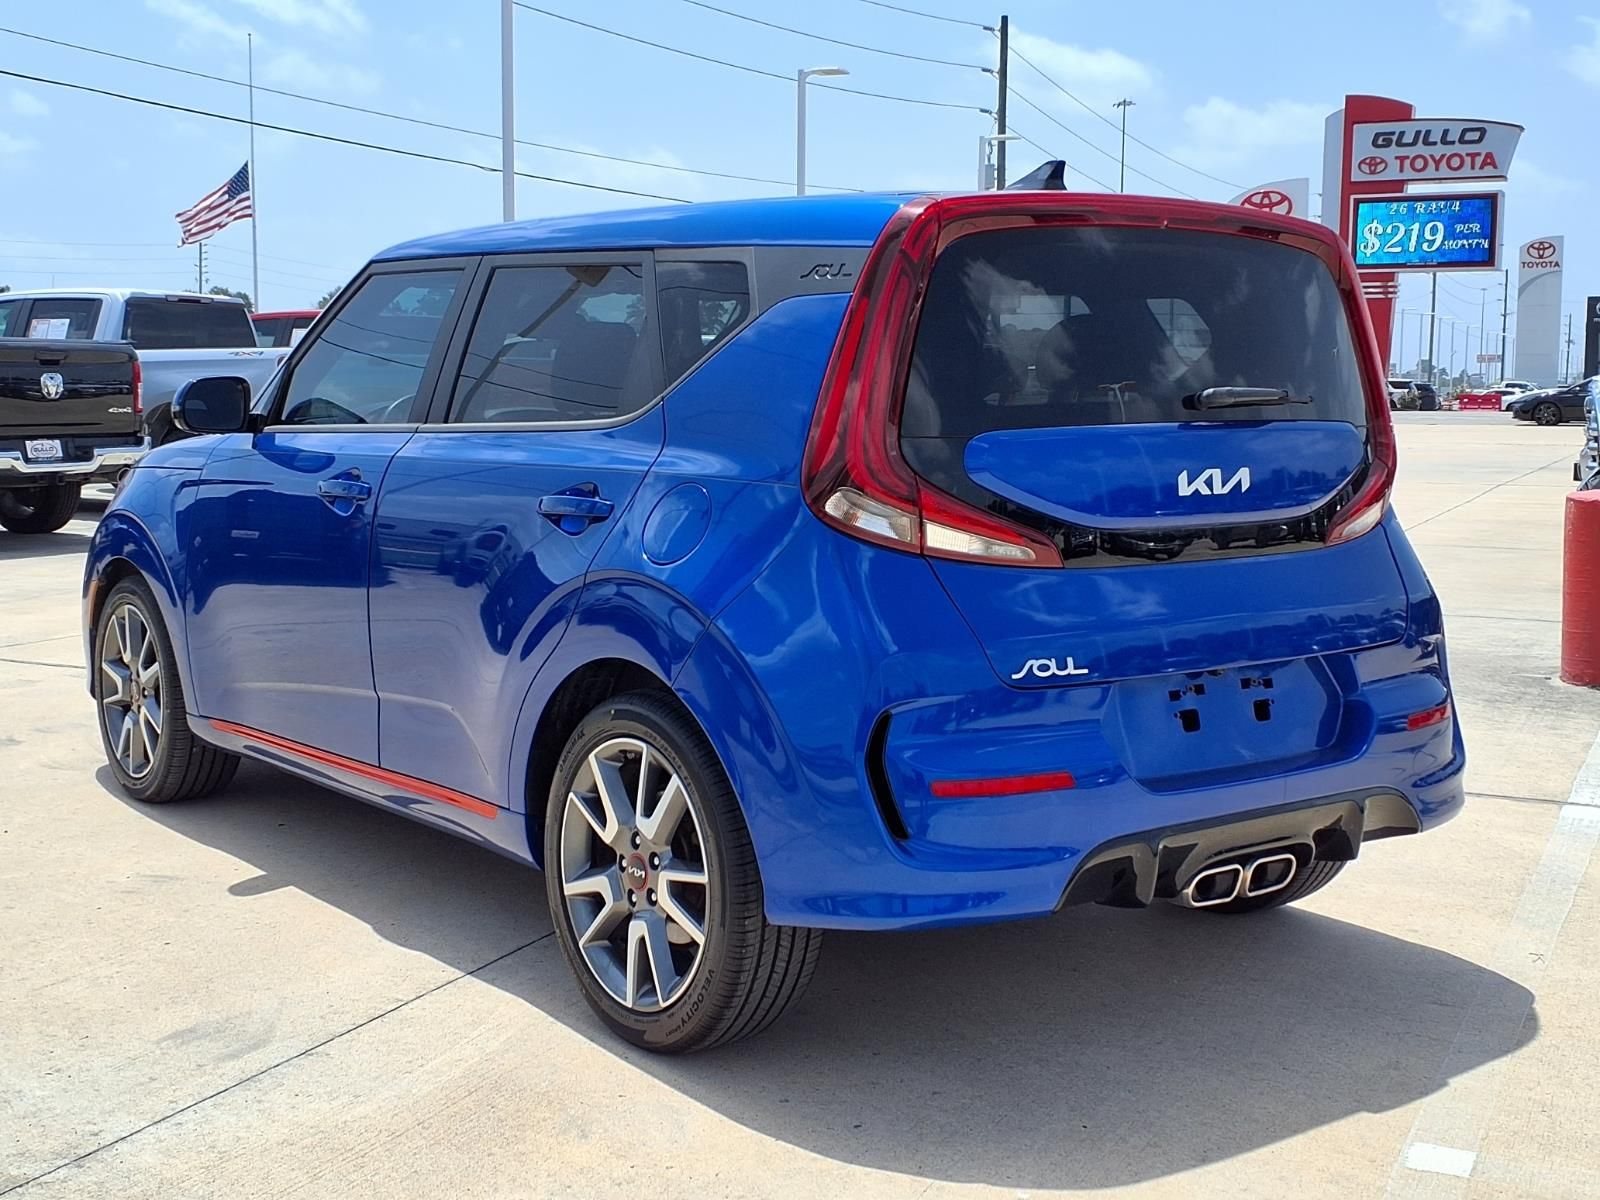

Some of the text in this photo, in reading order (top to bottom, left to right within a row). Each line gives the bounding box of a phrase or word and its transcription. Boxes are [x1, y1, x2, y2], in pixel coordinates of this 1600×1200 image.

[1371, 127, 1487, 149] GULLO
[1394, 152, 1498, 173] TOYOTA
[1360, 219, 1445, 257] $219
[1454, 223, 1481, 234] PER
[800, 263, 853, 279] SOUL
[1521, 260, 1560, 269] TOYOTA
[1178, 467, 1251, 496] KIA
[1011, 656, 1089, 680] SOUL
[680, 968, 715, 1027] VELOCITY
